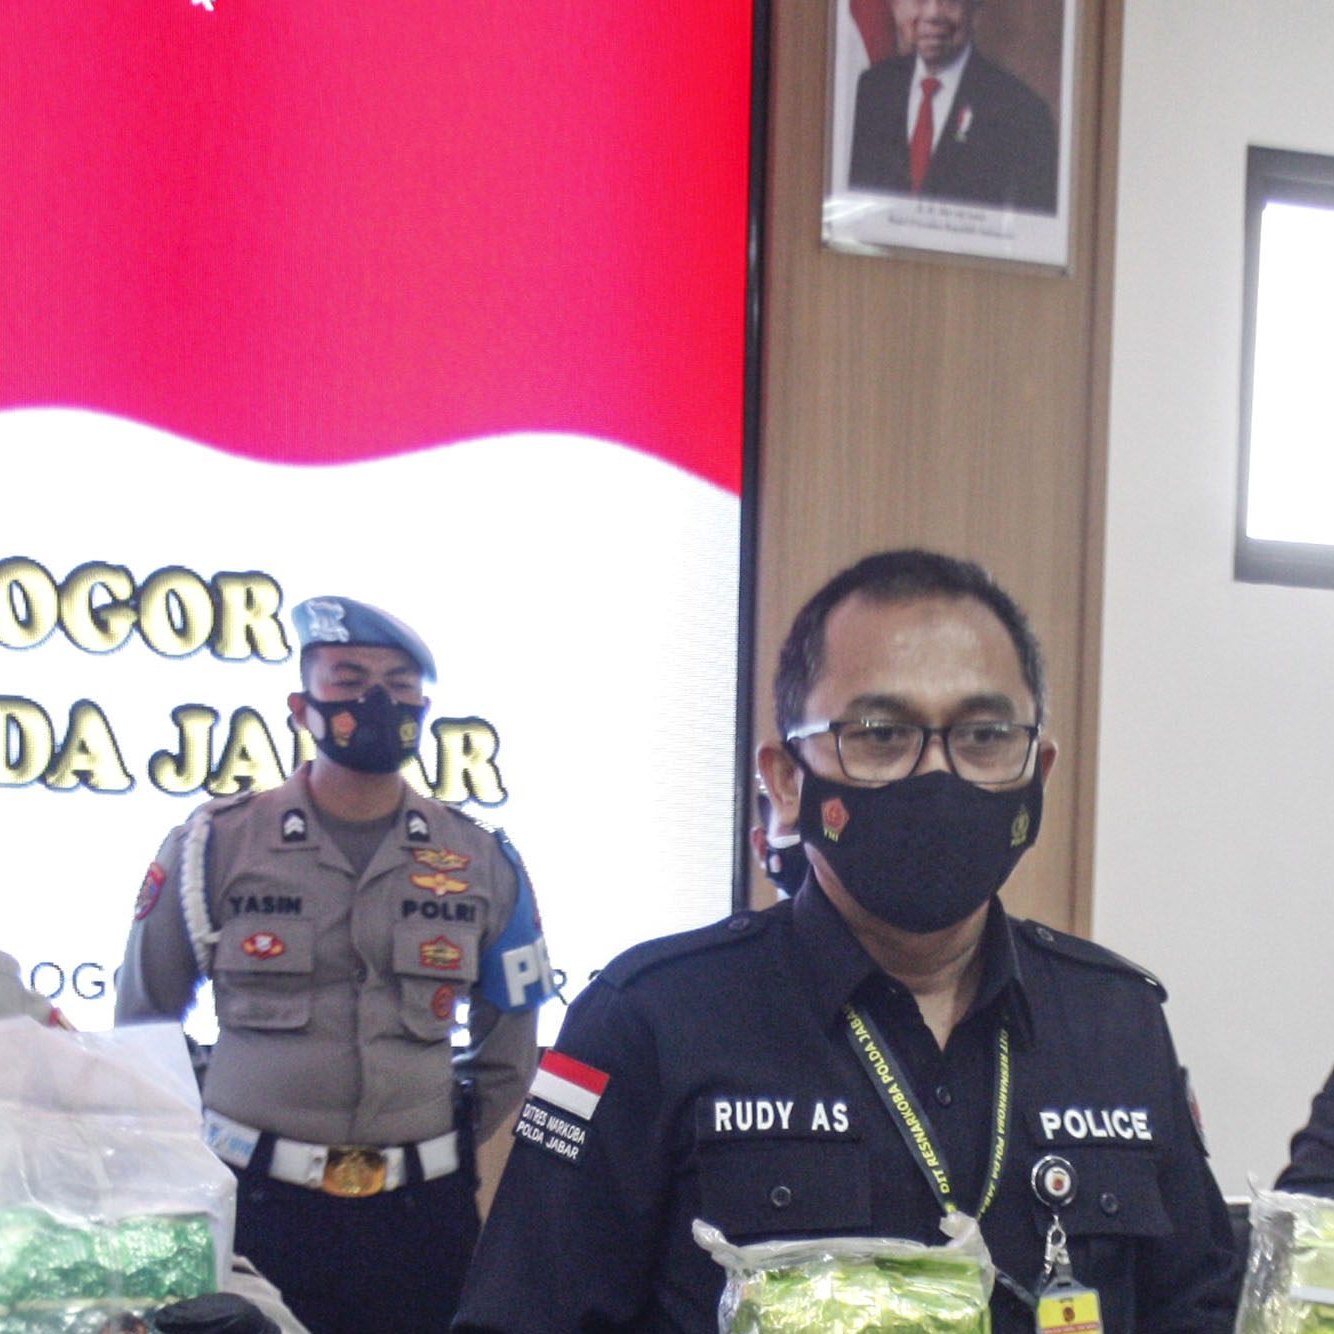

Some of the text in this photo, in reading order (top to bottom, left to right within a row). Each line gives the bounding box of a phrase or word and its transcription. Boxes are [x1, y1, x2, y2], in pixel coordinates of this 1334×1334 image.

[229, 896, 303, 916] YASIN
[401, 899, 476, 923] POLRI
[864, 1042, 895, 1084] POLDA
[546, 1115, 587, 1145] NARKOBA
[714, 1100, 850, 1132] RUDY AS
[888, 1083, 939, 1167] RESNARKOBA
[1040, 1109, 1152, 1140] POLICE
[515, 1120, 580, 1160] POLDA JABAR
[932, 1168, 951, 1194] DIT
